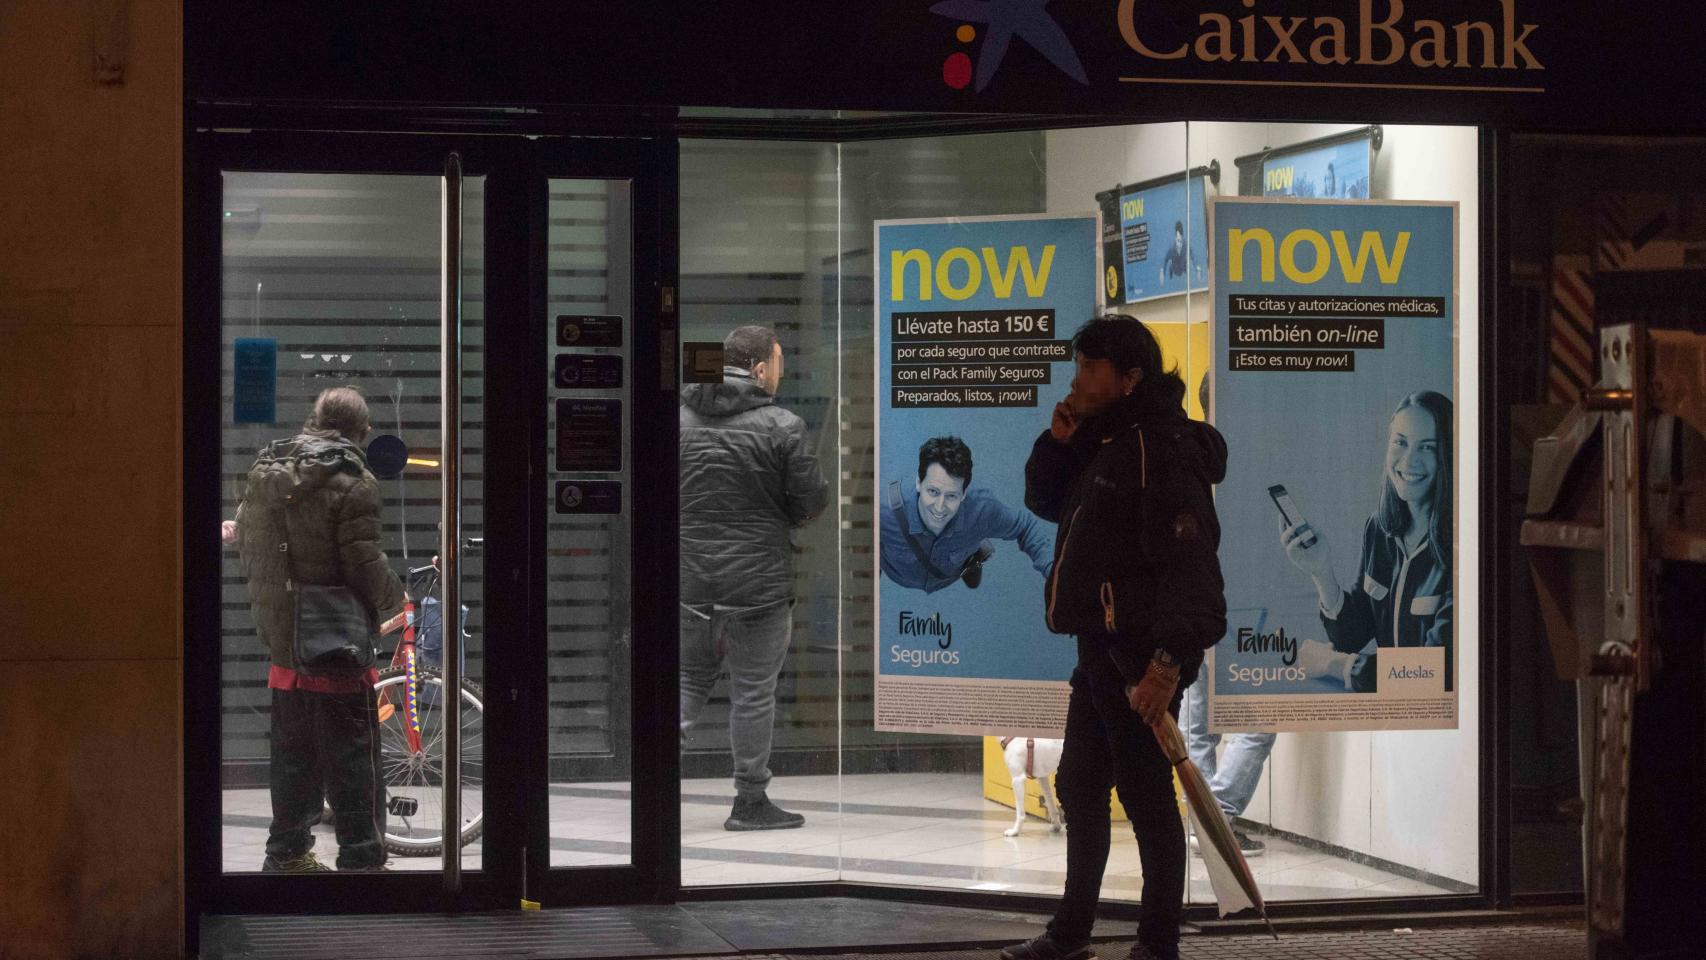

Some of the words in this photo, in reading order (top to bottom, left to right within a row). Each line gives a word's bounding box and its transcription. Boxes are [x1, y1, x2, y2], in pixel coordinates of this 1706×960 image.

[1117, 0, 1545, 70] CaixaBank
[1266, 166, 1294, 192] now
[1123, 198, 1144, 220] now
[1228, 228, 1412, 284] now
[891, 245, 1057, 301] now
[1236, 298, 1257, 311] Tus
[1259, 298, 1287, 311] citas
[1288, 301, 1296, 314] y
[1298, 299, 1386, 312] autorizaciones
[1388, 300, 1440, 314] médicas,
[897, 317, 953, 335] Llévate
[957, 316, 1000, 334] hasta
[1005, 315, 1033, 332] 150
[1036, 315, 1049, 332] €
[1236, 324, 1312, 343] también
[1316, 324, 1379, 343] on-line
[897, 347, 916, 361] por
[919, 346, 946, 358] cada
[947, 346, 986, 360] seguro
[988, 346, 1011, 359] que
[1012, 343, 1067, 357] contrates
[1235, 353, 1266, 369] ¡Esto
[1269, 356, 1283, 366] es
[1285, 356, 1313, 368] muy
[1315, 354, 1349, 367] now!
[897, 370, 919, 381] con
[920, 367, 931, 380] el
[933, 367, 958, 380] Pack
[961, 366, 998, 382] Family
[999, 366, 1045, 382] Seguros
[897, 390, 962, 405] Preparados,
[964, 389, 996, 404] listos,
[998, 388, 1033, 404] ¡now!
[899, 611, 952, 650] Family
[891, 644, 960, 668] Seguros
[1238, 627, 1298, 666] Family
[1228, 663, 1306, 687] Seguros
[1388, 665, 1435, 679] Adeslas
